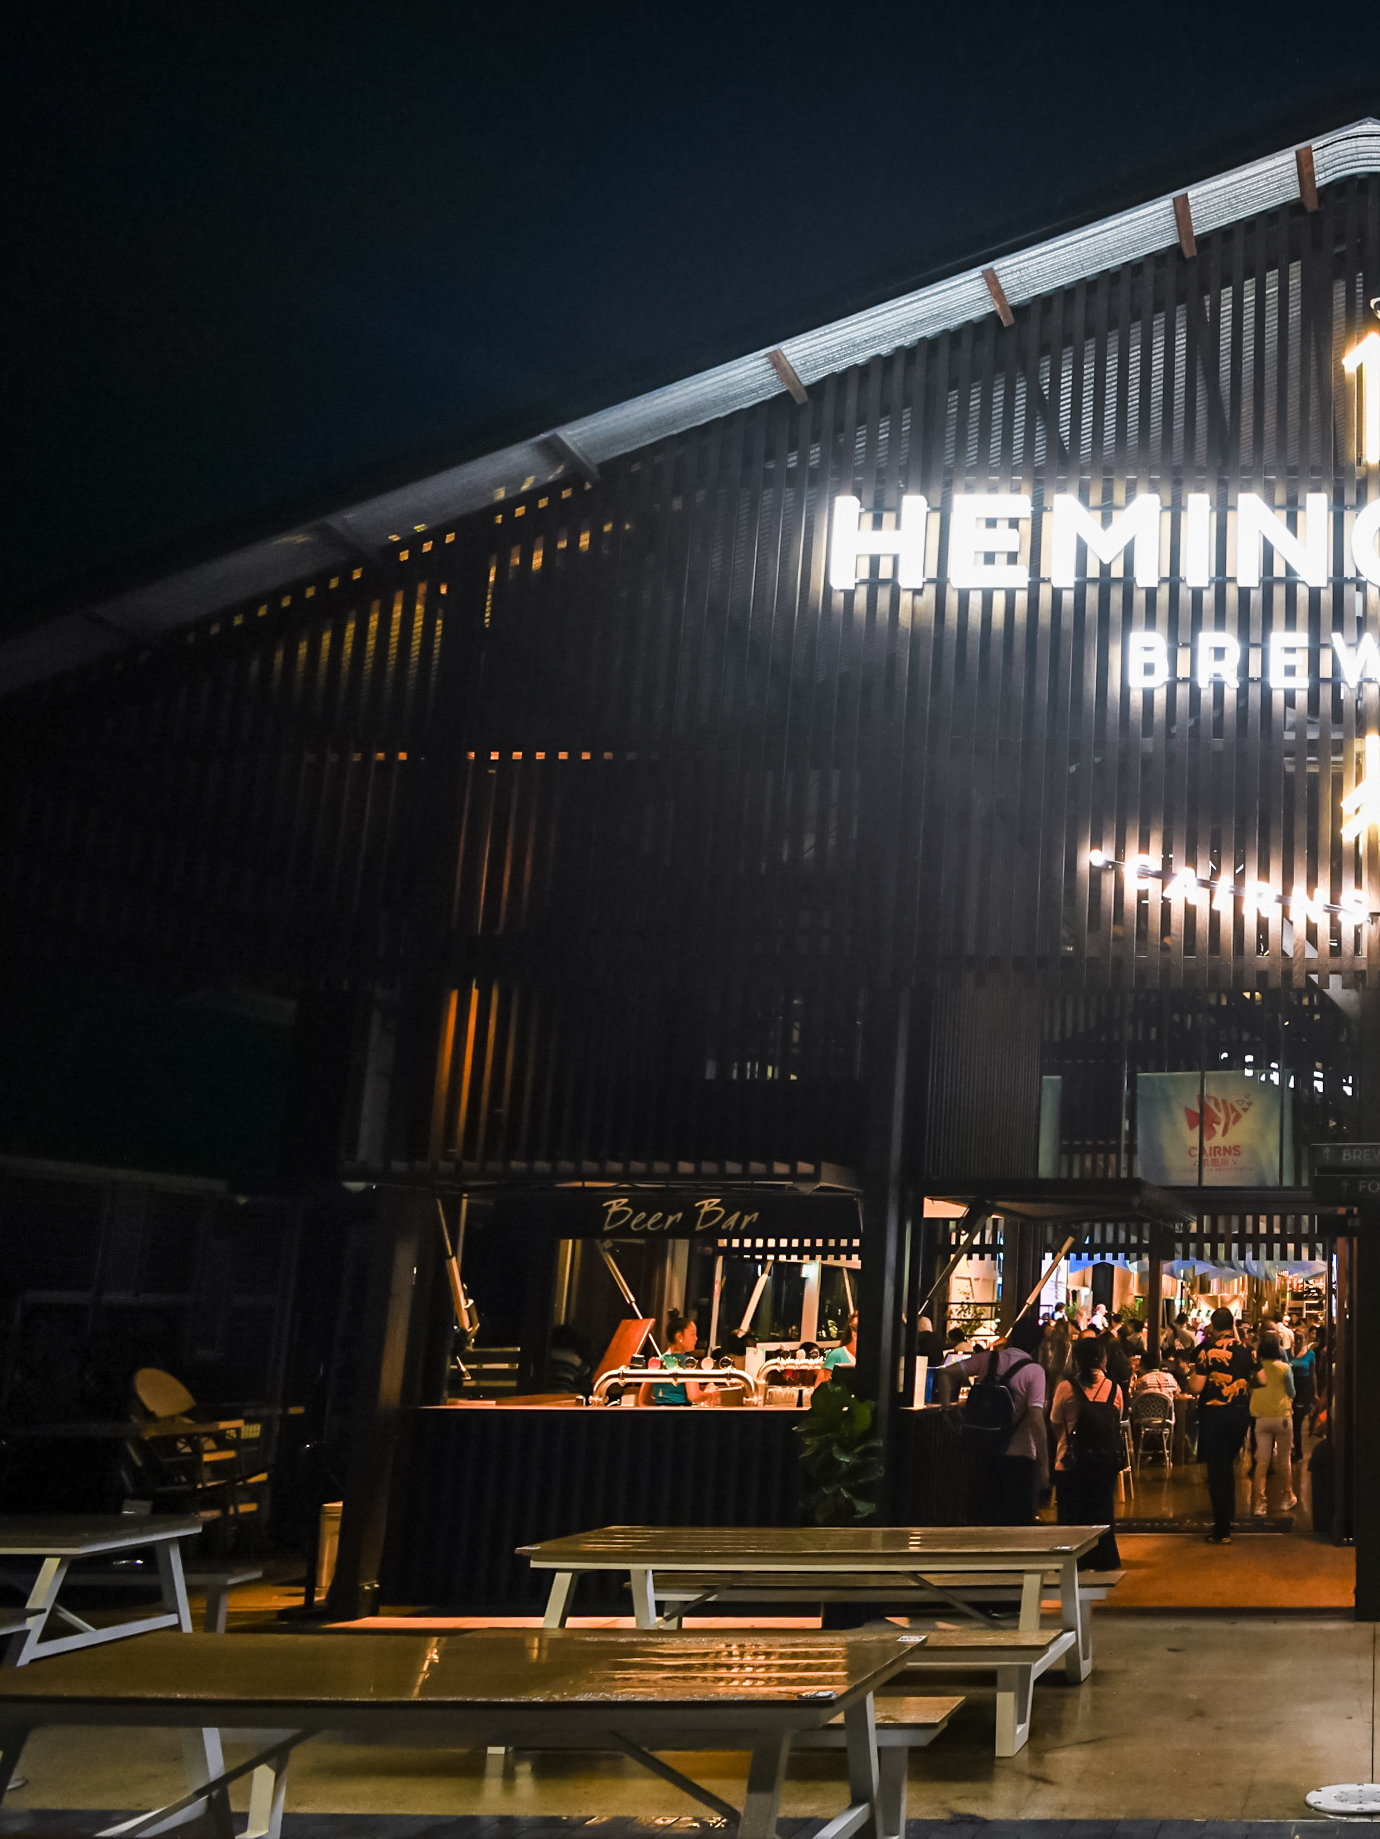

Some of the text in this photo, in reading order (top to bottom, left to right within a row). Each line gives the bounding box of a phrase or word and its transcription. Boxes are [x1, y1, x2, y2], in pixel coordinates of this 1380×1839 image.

[1124, 853, 1370, 926] CAIRNS
[602, 1198, 760, 1232] Beer Bar
